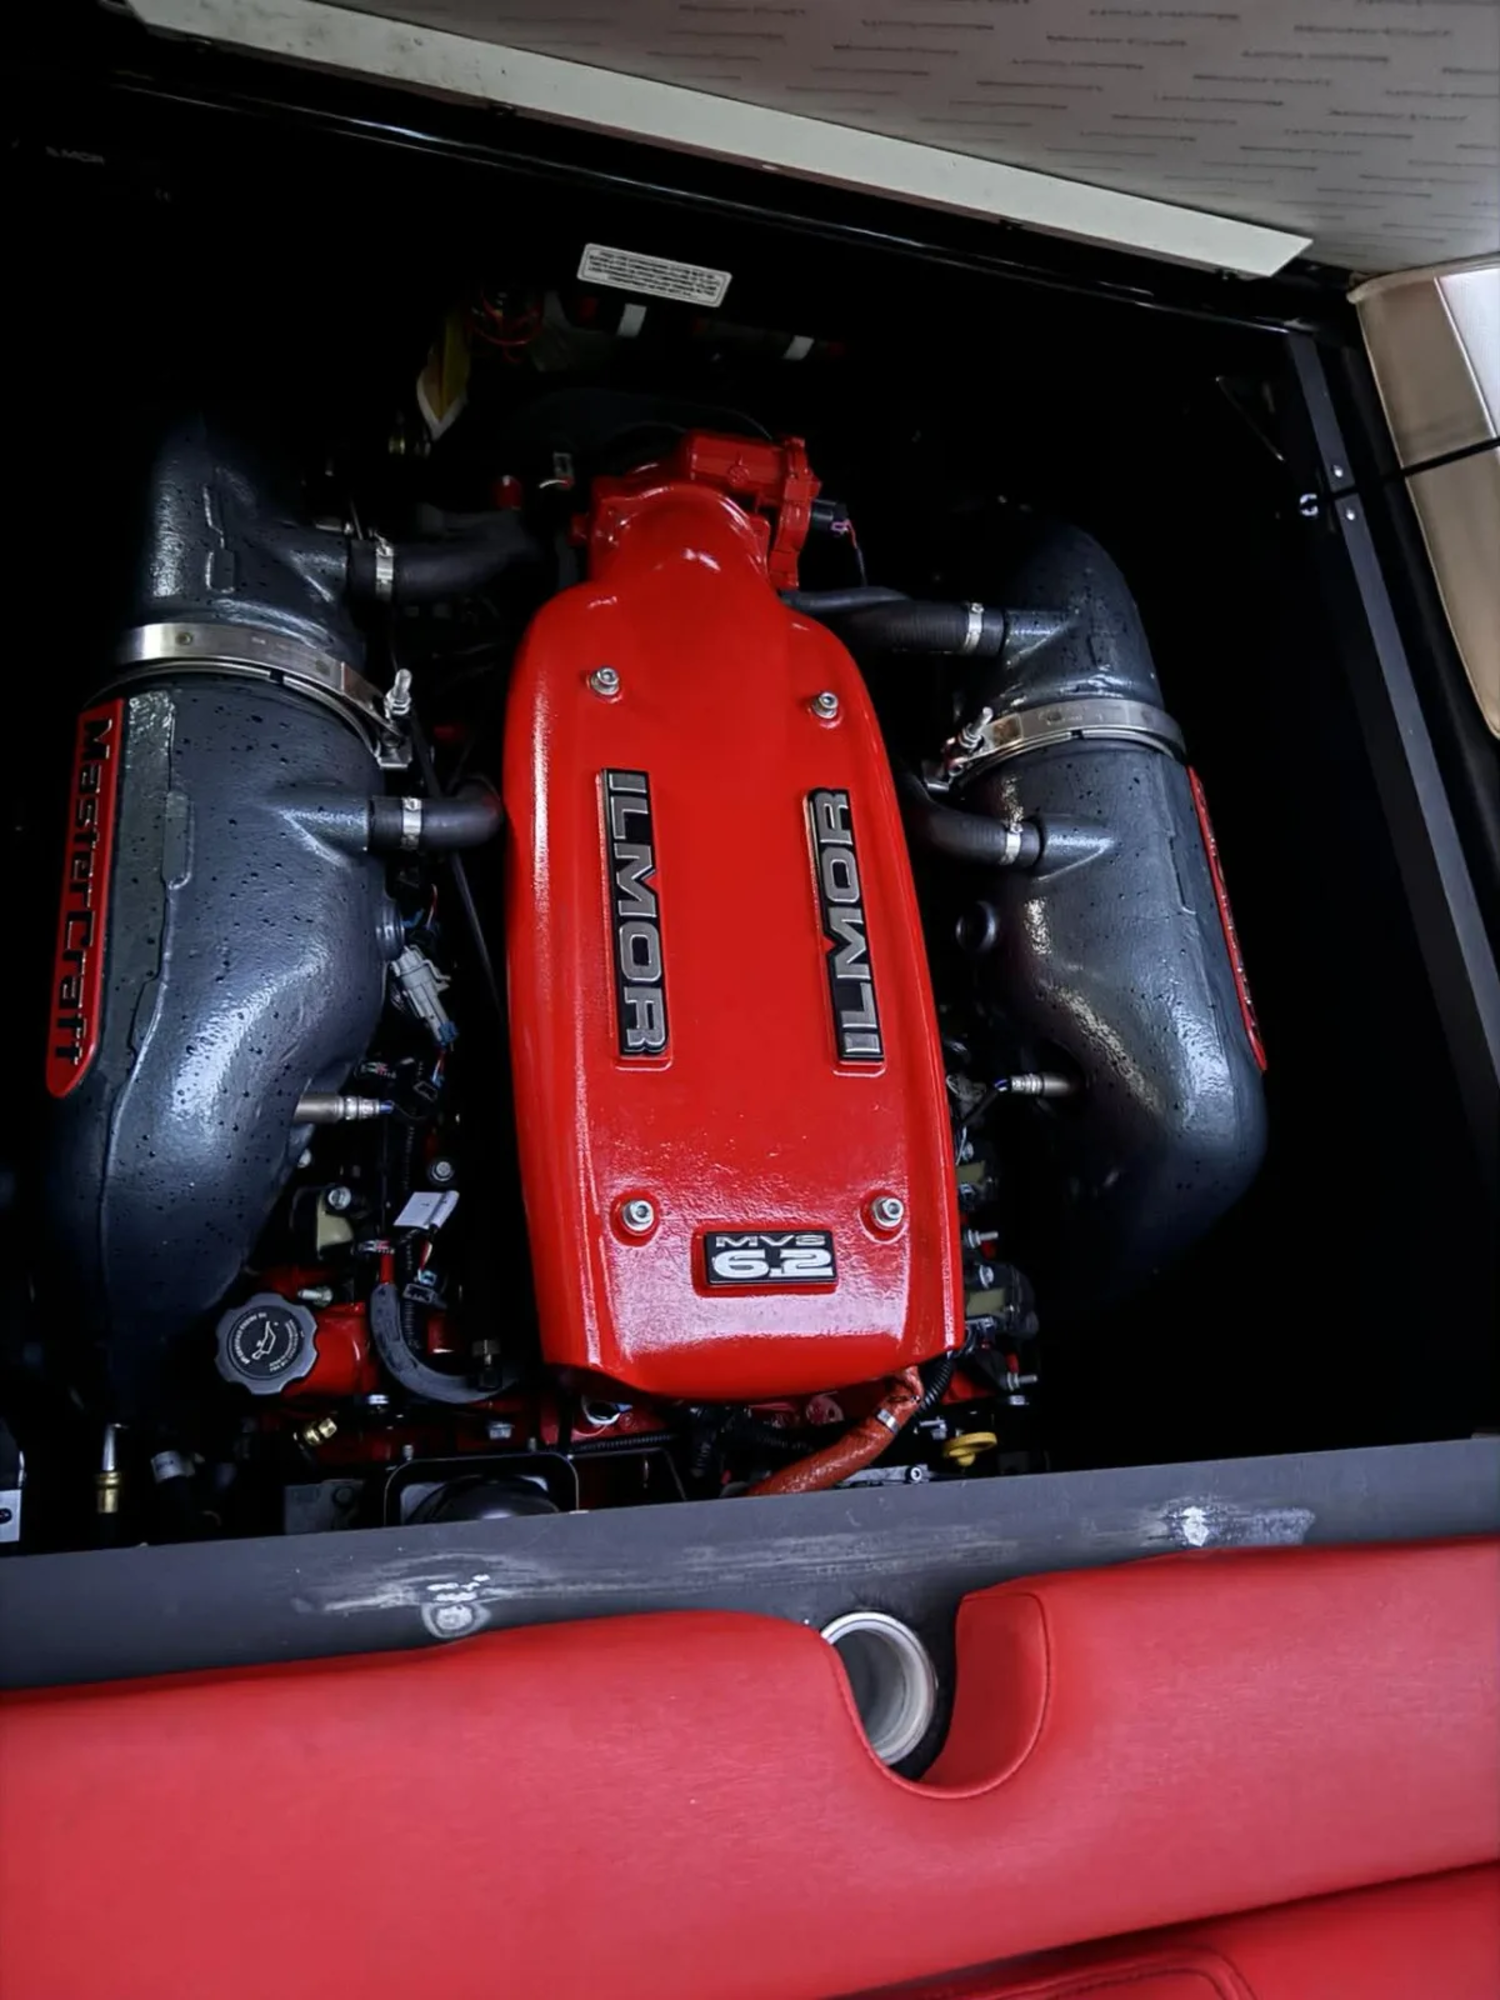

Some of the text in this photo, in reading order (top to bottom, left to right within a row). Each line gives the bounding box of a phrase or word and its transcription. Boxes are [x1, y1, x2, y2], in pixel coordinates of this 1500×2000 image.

[56, 717, 113, 1065] MasterCraft
[607, 771, 667, 1053] ILMOR
[813, 788, 882, 1055] ILMOR
[711, 1248, 834, 1279] 6.2
[715, 1234, 826, 1248] MVS
